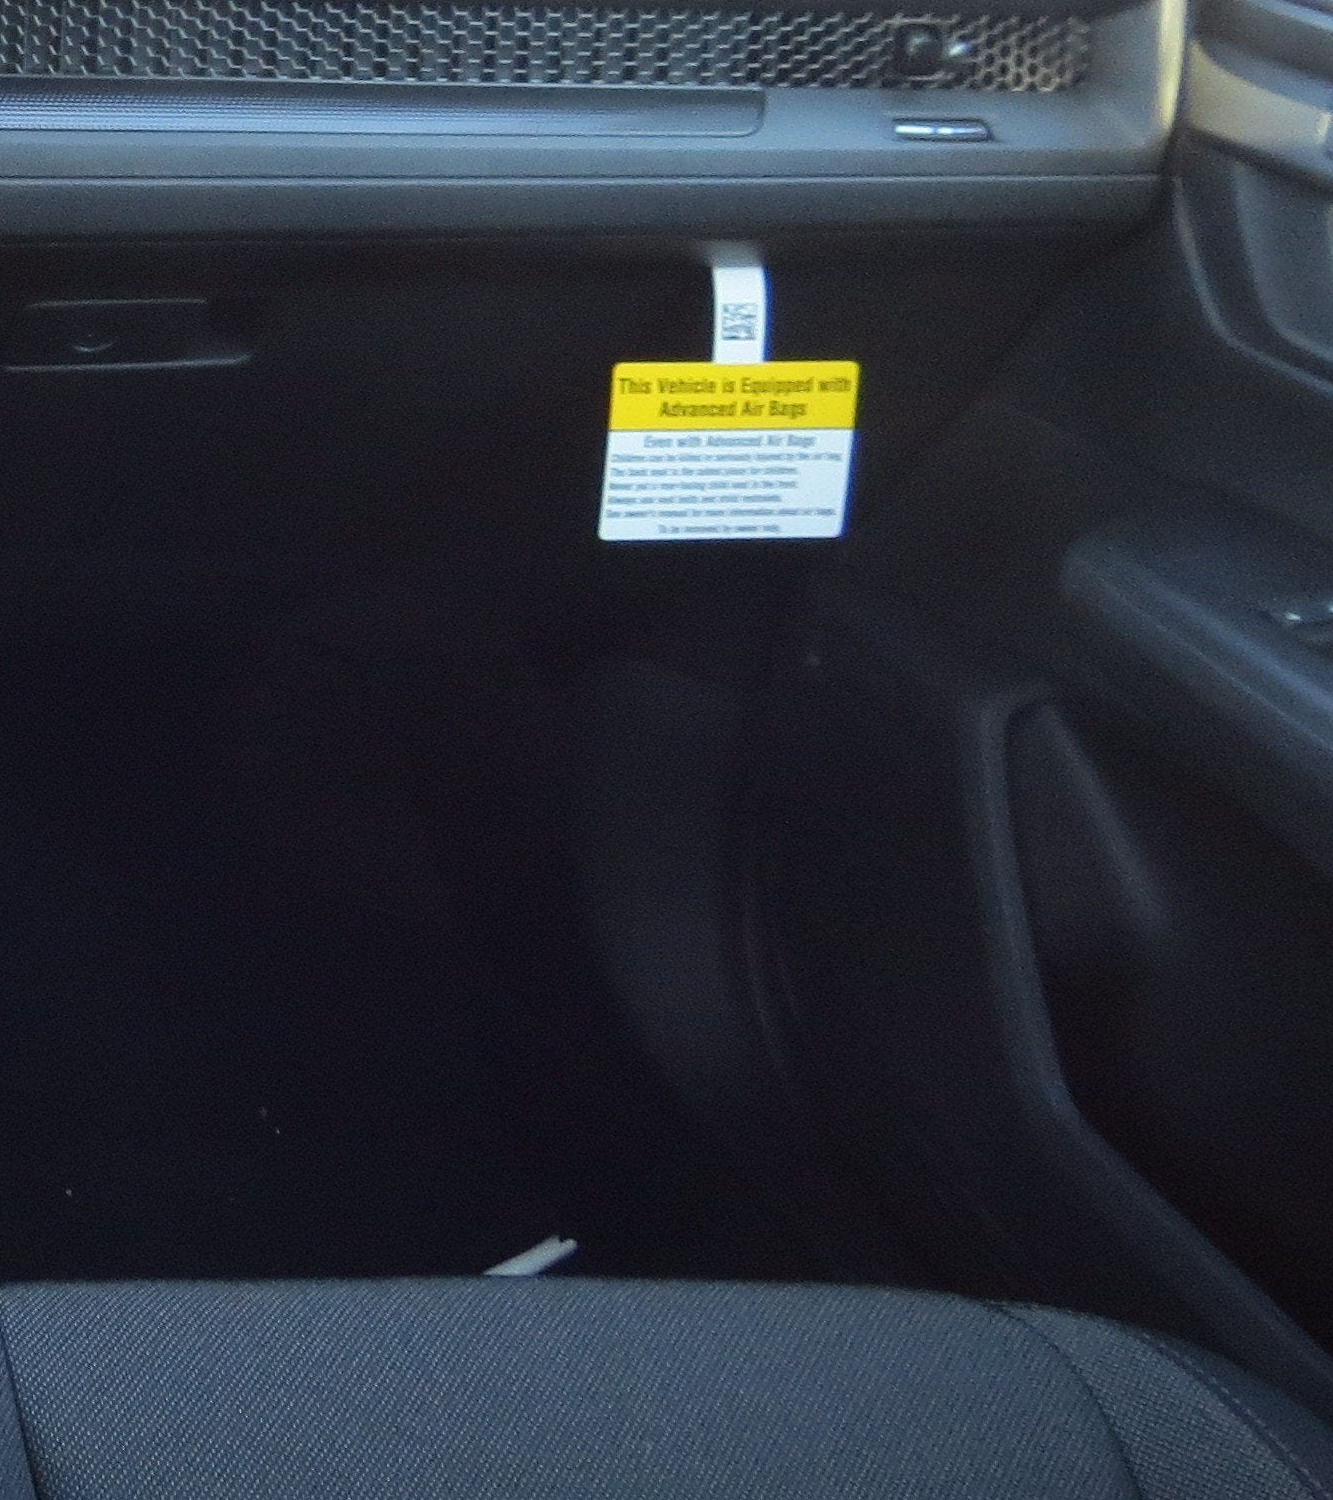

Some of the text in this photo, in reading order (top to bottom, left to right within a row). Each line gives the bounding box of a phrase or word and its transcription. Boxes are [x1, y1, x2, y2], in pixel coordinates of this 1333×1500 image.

[619, 376, 851, 397] This Vehicle is Equipped with
[660, 401, 808, 419] Advanced Air Bags
